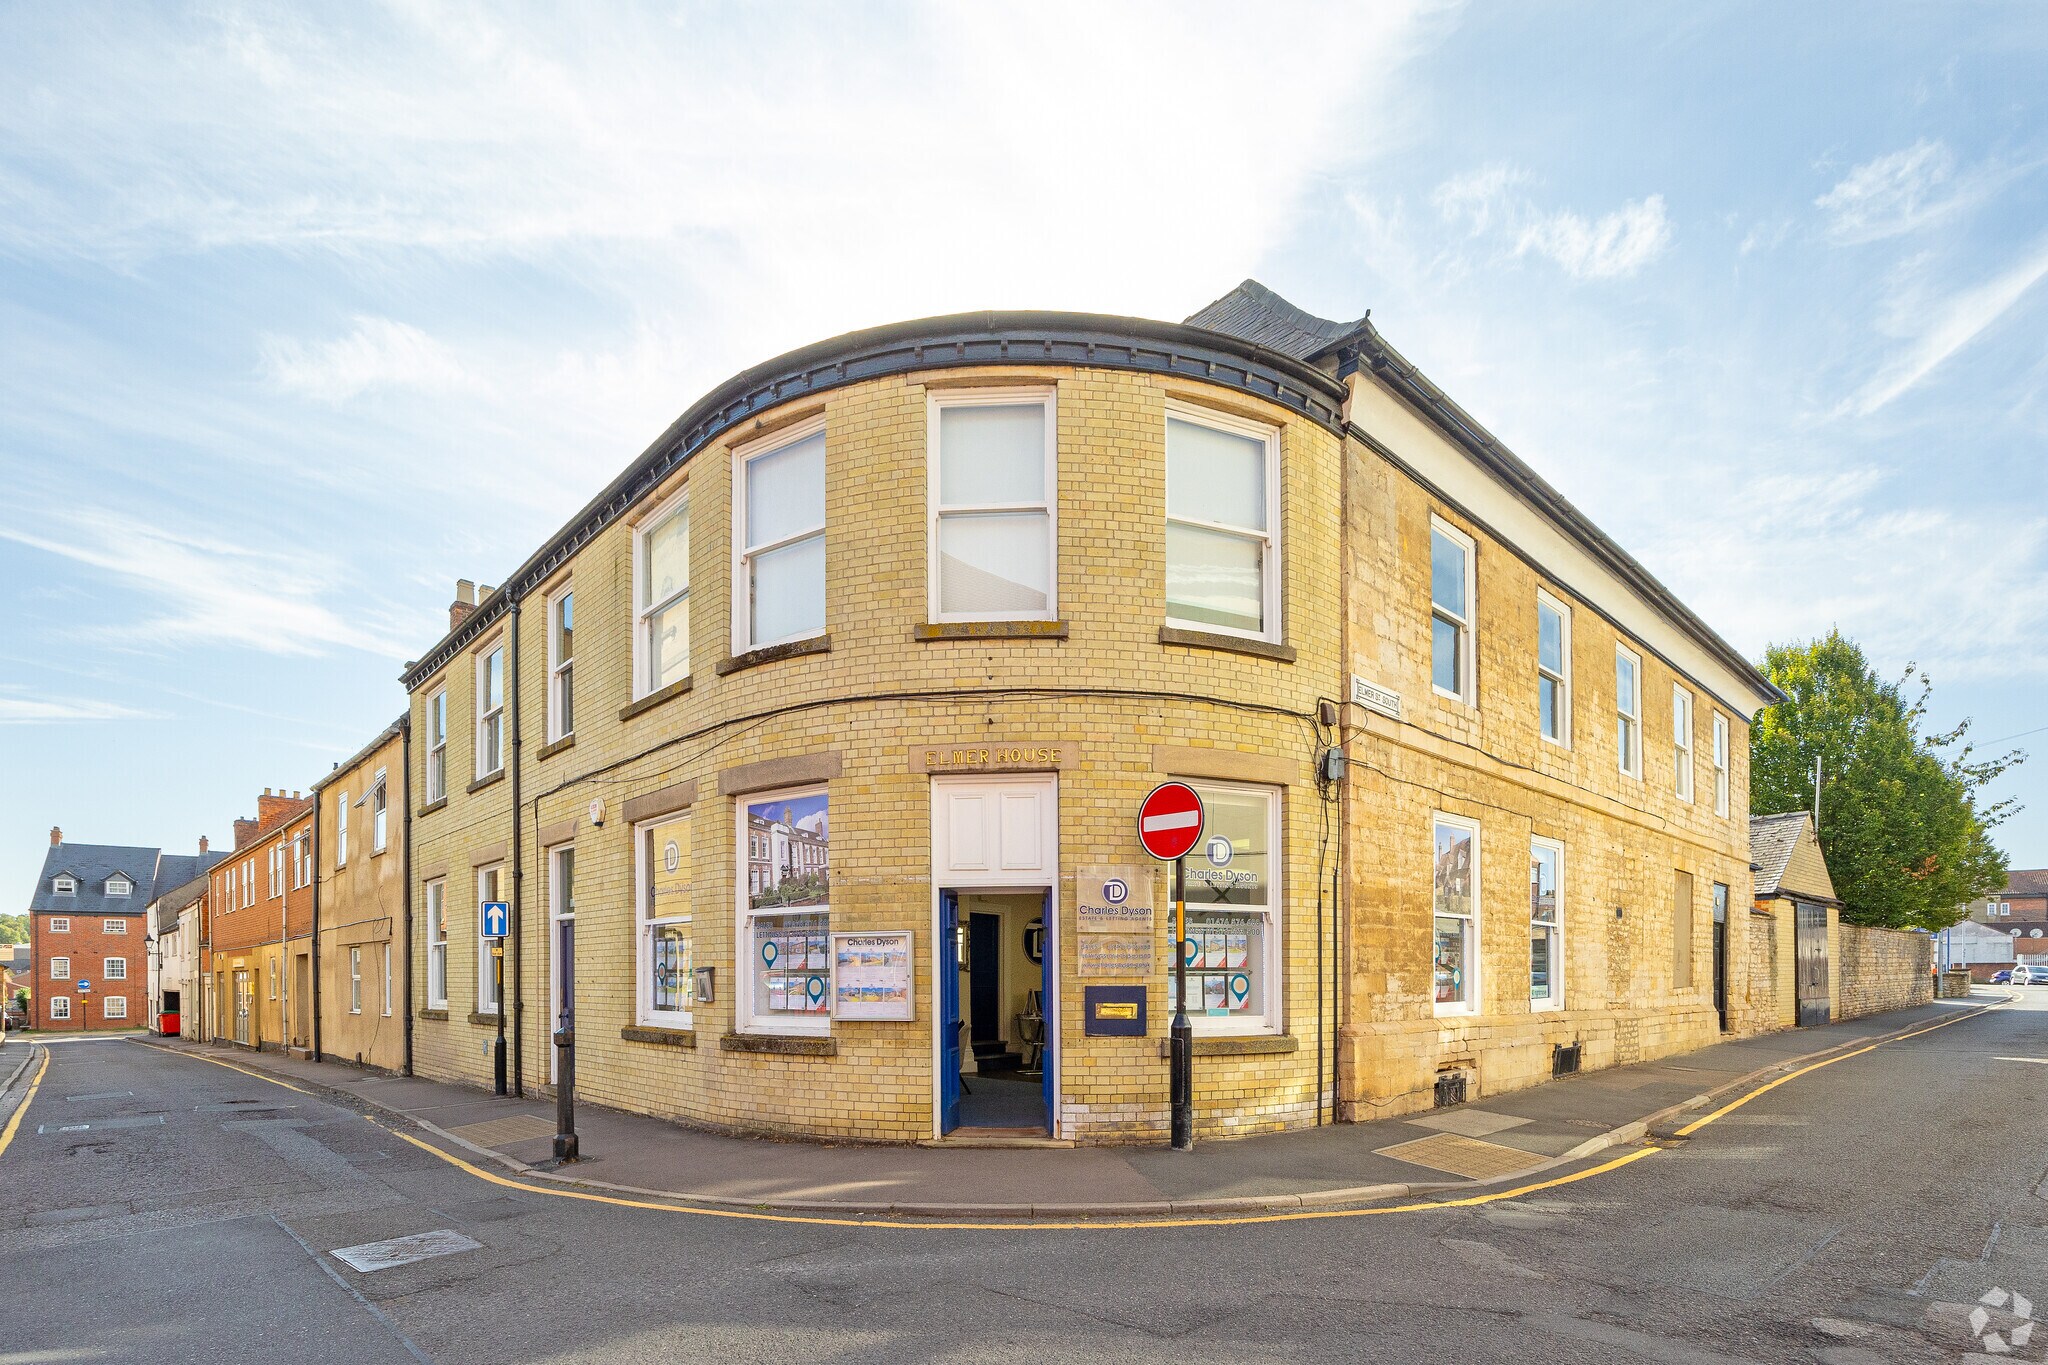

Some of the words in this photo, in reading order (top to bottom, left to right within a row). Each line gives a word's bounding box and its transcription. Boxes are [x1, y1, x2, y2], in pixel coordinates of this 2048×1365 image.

[1357, 685, 1374, 699] ELMER
[1382, 695, 1398, 708] SOUTH
[925, 749, 989, 765] ELMER
[996, 748, 1062, 763] HOUSE
[1225, 869, 1258, 883] Dyson
[1079, 905, 1119, 915] Charles
[1121, 906, 1152, 916] Dyson
[847, 938, 875, 946] Charles
[876, 938, 899, 946] Dyson
